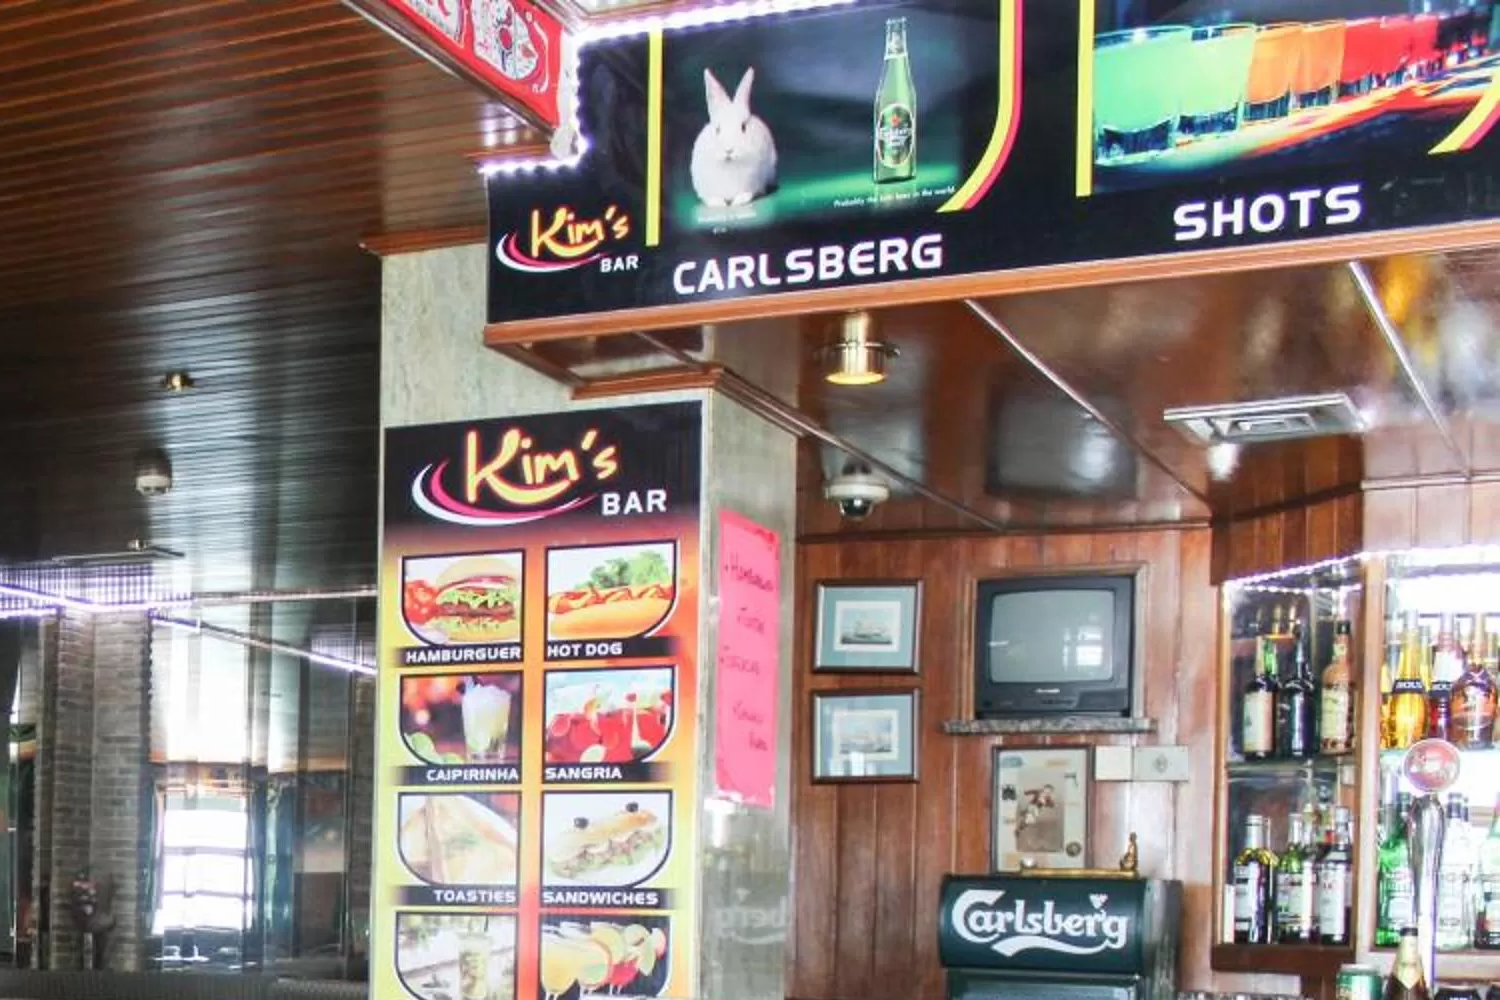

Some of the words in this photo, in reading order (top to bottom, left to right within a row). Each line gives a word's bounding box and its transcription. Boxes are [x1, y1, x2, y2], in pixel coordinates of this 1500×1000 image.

[1173, 184, 1362, 241] SHOTS
[529, 204, 630, 259] Kim's
[600, 253, 640, 274] BAR
[673, 233, 944, 295] CARLSBERG
[466, 428, 619, 506] Kim's
[602, 489, 668, 516] BAR
[406, 647, 521, 664] HAMBURGUER
[547, 643, 581, 658] HOT
[586, 642, 623, 657] DOG
[426, 767, 519, 782] CAIPIRINHA
[545, 766, 623, 781] SANGRIA
[433, 888, 517, 904] TOASTIES
[544, 891, 659, 906] SANDWICHES
[952, 889, 1128, 956] Carlsberg
